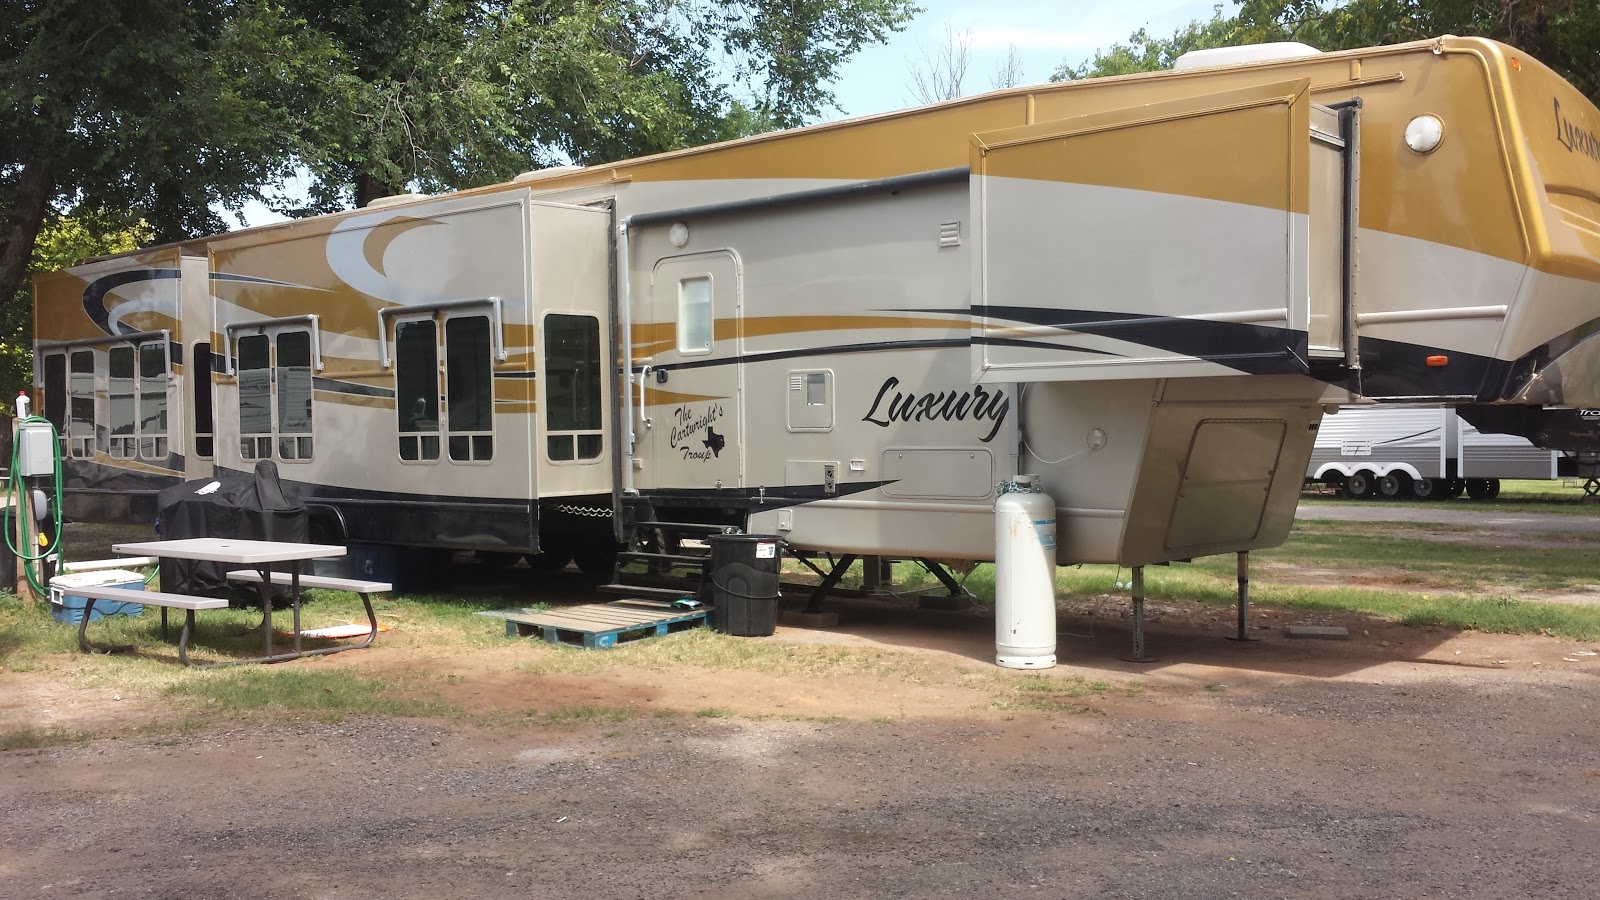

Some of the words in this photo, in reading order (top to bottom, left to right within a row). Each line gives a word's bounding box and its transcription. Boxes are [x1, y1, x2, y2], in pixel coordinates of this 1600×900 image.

[670, 403, 724, 449] Cartwright's
[674, 404, 692, 426] The
[862, 376, 1009, 442] Luxury
[680, 446, 712, 463] Troup
